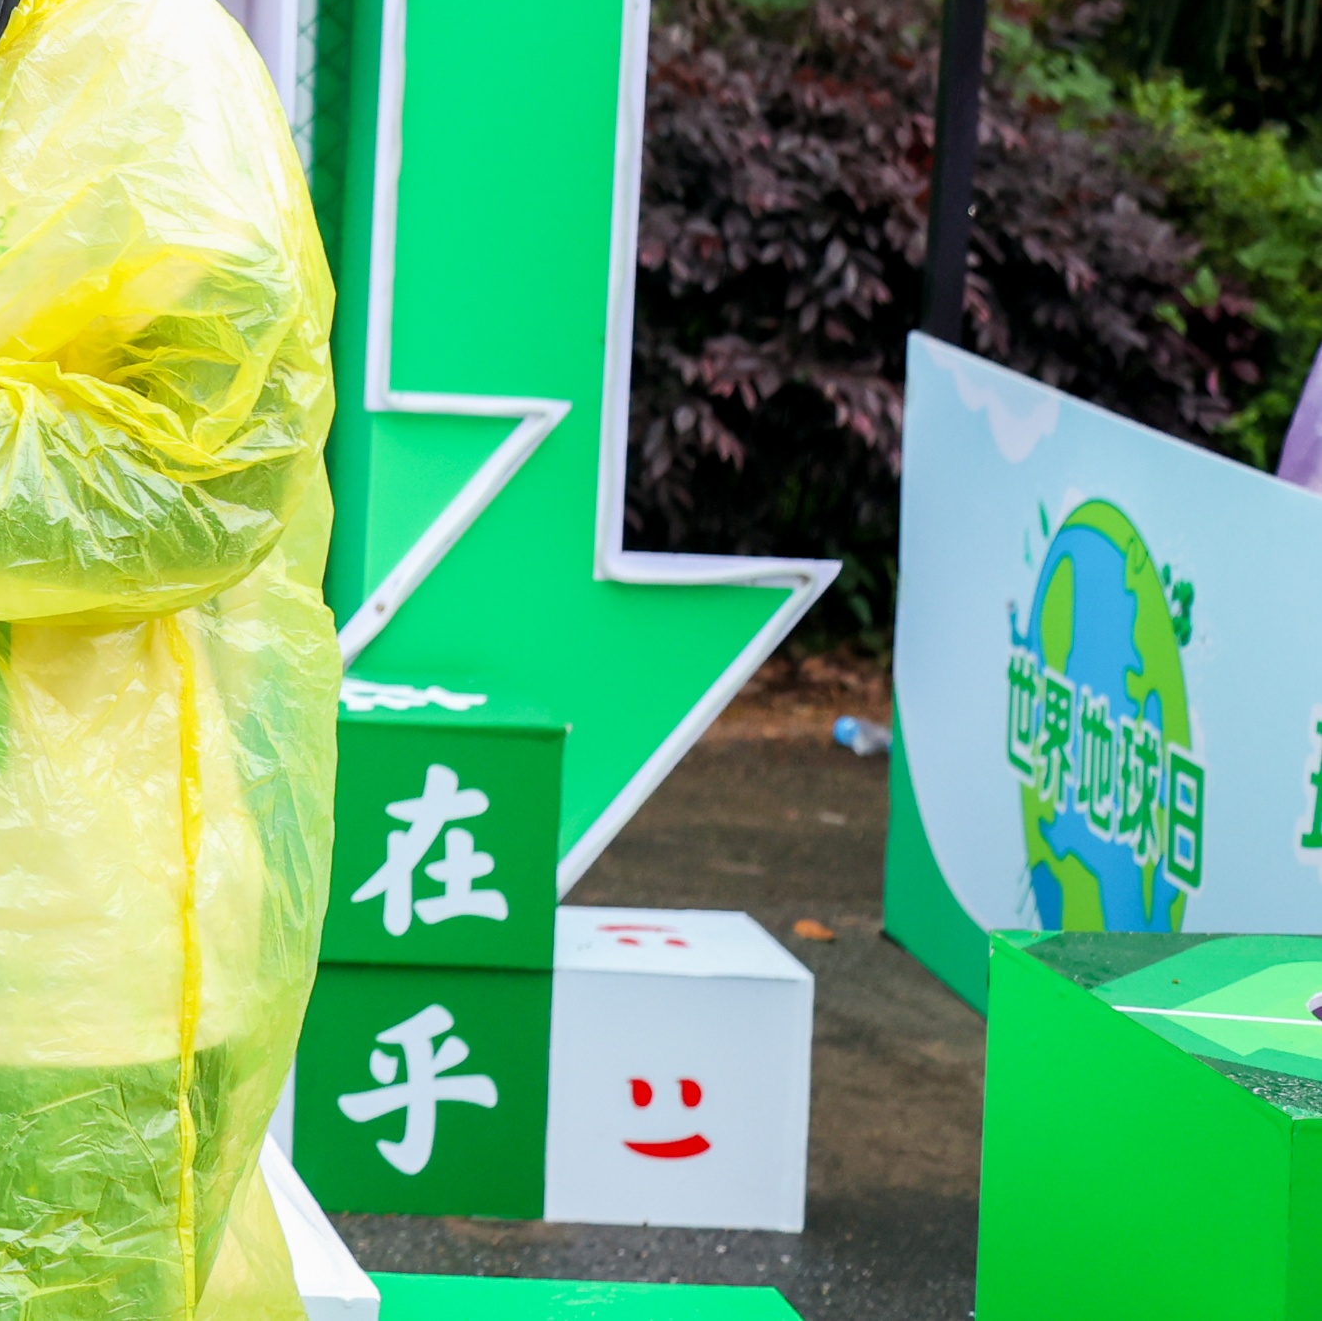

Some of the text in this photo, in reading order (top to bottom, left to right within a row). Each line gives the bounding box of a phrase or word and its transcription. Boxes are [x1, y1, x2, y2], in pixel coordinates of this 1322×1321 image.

[1006, 654, 1207, 890] 世界地球日
